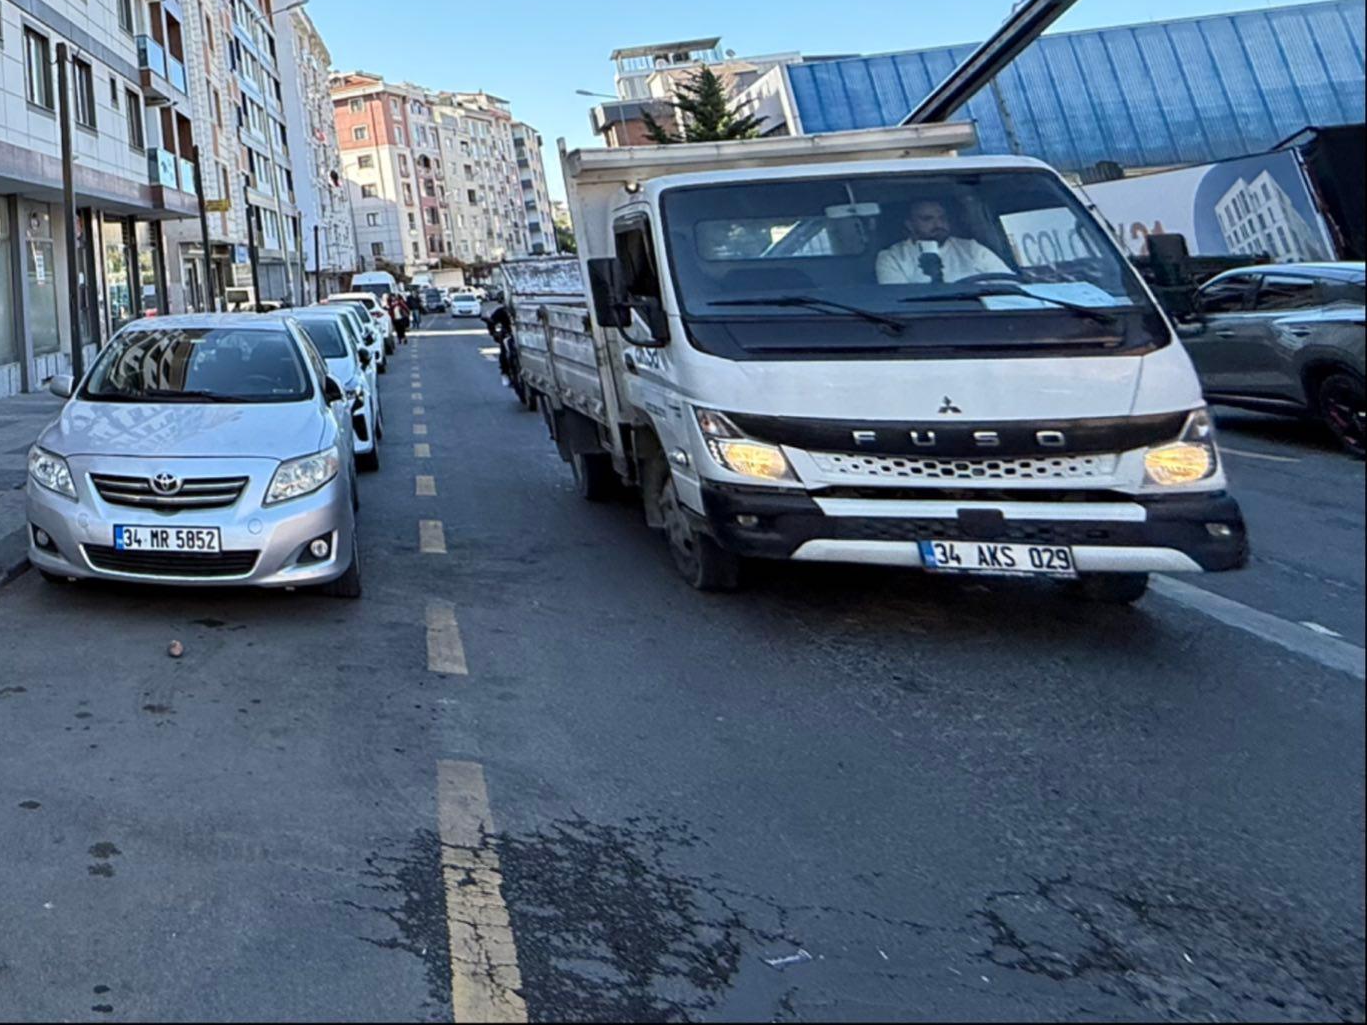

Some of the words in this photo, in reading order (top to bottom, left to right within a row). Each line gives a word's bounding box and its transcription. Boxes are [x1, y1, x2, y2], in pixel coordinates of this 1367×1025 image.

[852, 430, 1066, 447] FUSO
[124, 528, 142, 547] 34
[150, 529, 169, 548] MR
[175, 530, 216, 550] 5852
[934, 543, 961, 565] 34
[977, 545, 1016, 567] AKS
[1028, 547, 1070, 570] 029
